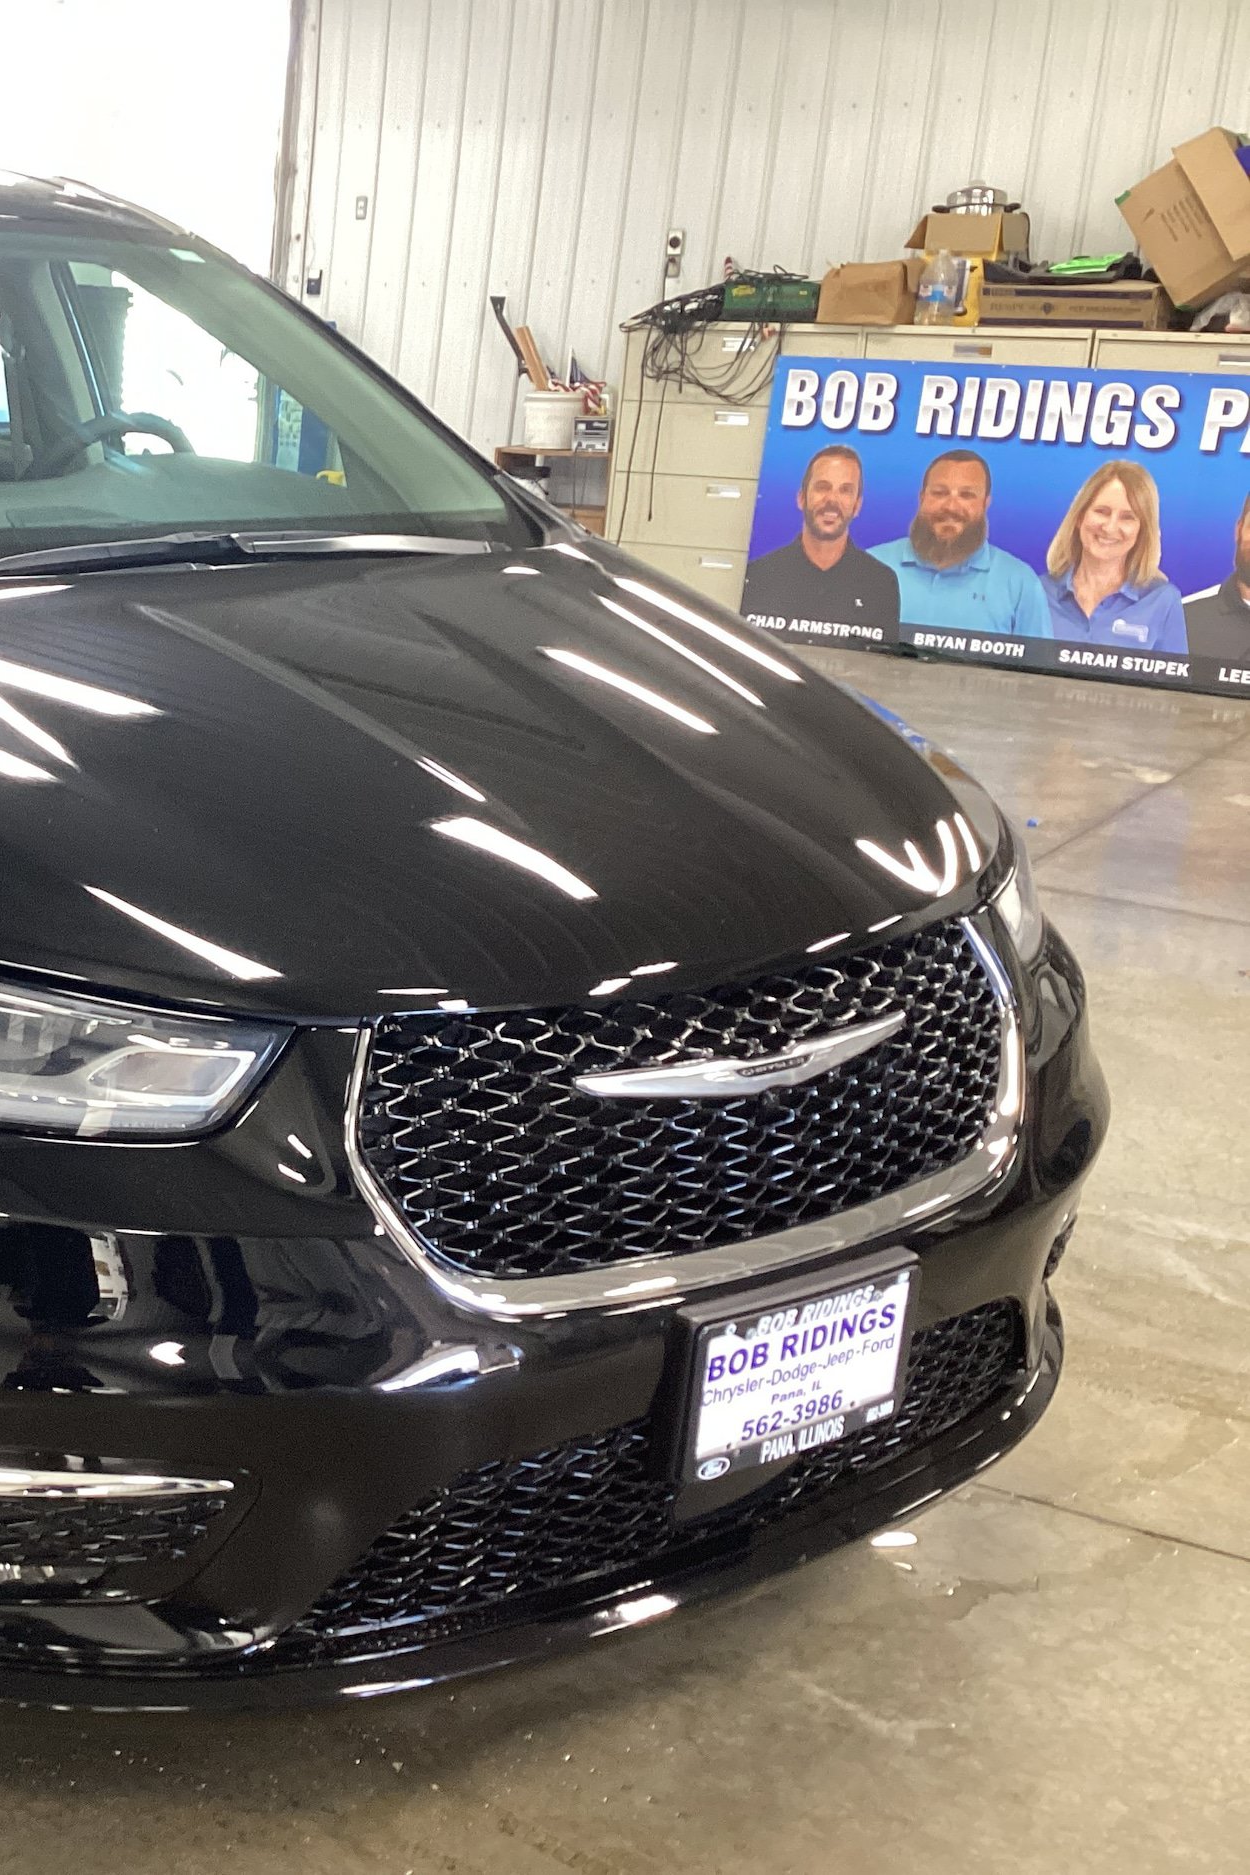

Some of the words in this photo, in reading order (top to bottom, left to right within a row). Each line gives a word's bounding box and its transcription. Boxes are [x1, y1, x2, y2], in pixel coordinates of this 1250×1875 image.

[781, 368, 898, 432] BOB
[915, 375, 1181, 449] RIDINGS
[1199, 387, 1250, 454] P
[746, 613, 787, 630] CHAD
[788, 618, 884, 641] ARMSTRONG
[913, 632, 967, 651] BRYAN
[969, 639, 1025, 658] BOOTH
[1058, 649, 1119, 669] SARAH
[1121, 656, 1190, 678] STUPEK
[1218, 667, 1250, 685] LEE
[756, 1308, 799, 1337] BOB
[799, 1284, 876, 1325] RIDINGS
[707, 1341, 770, 1384] BOB
[780, 1302, 897, 1362] RIDINGS
[811, 1380, 823, 1392] IL
[741, 1389, 844, 1442] 562-3986
[797, 1415, 846, 1452] ILLINOIS
